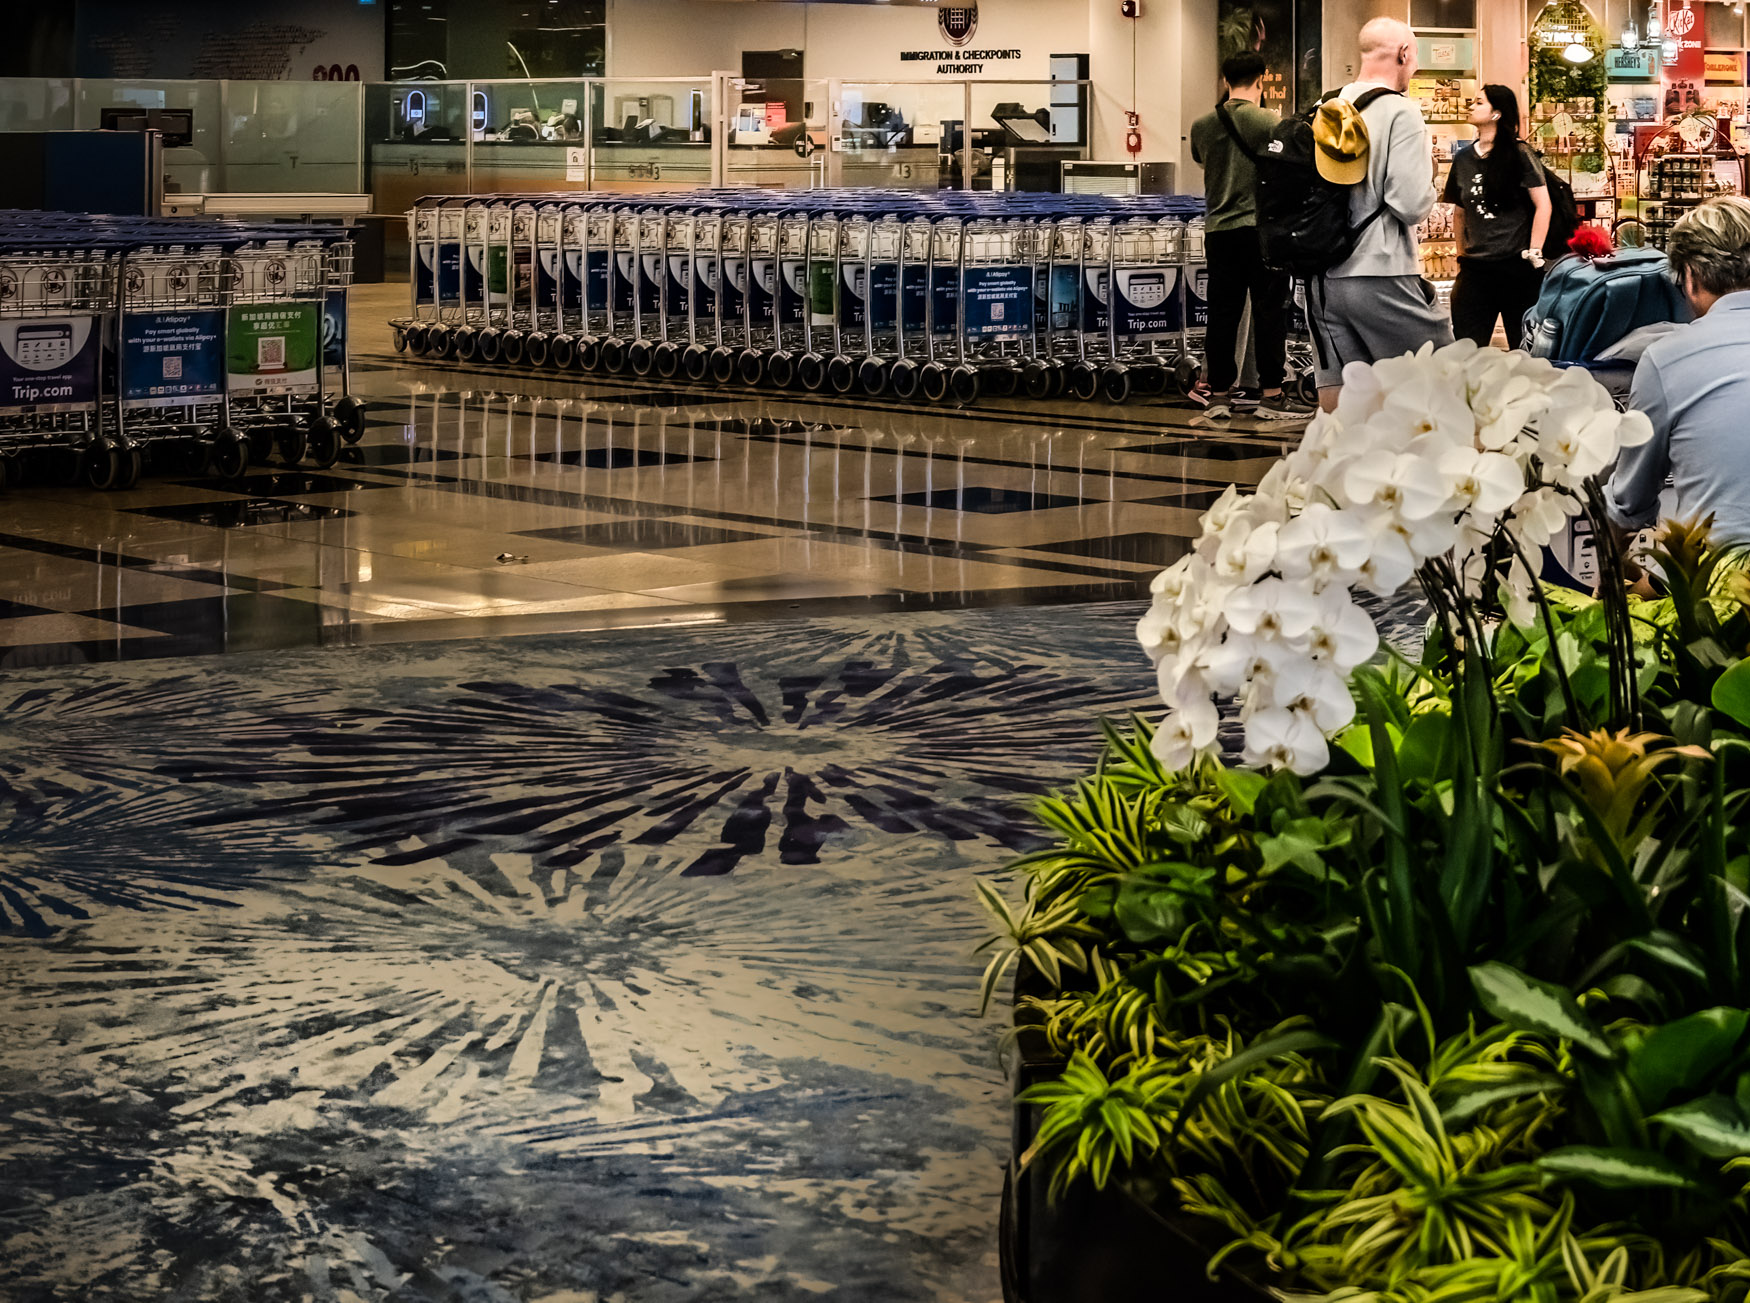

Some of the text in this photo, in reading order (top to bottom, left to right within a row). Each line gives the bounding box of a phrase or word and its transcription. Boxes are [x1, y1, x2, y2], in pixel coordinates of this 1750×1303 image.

[901, 51, 953, 60] IMMIGRATION
[962, 49, 1021, 60] CHECKPOINTS
[937, 63, 983, 74] AUTHORITY
[1127, 319, 1167, 331] Trip.com
[176, 327, 199, 335] globally
[12, 385, 72, 401] Trip.com
